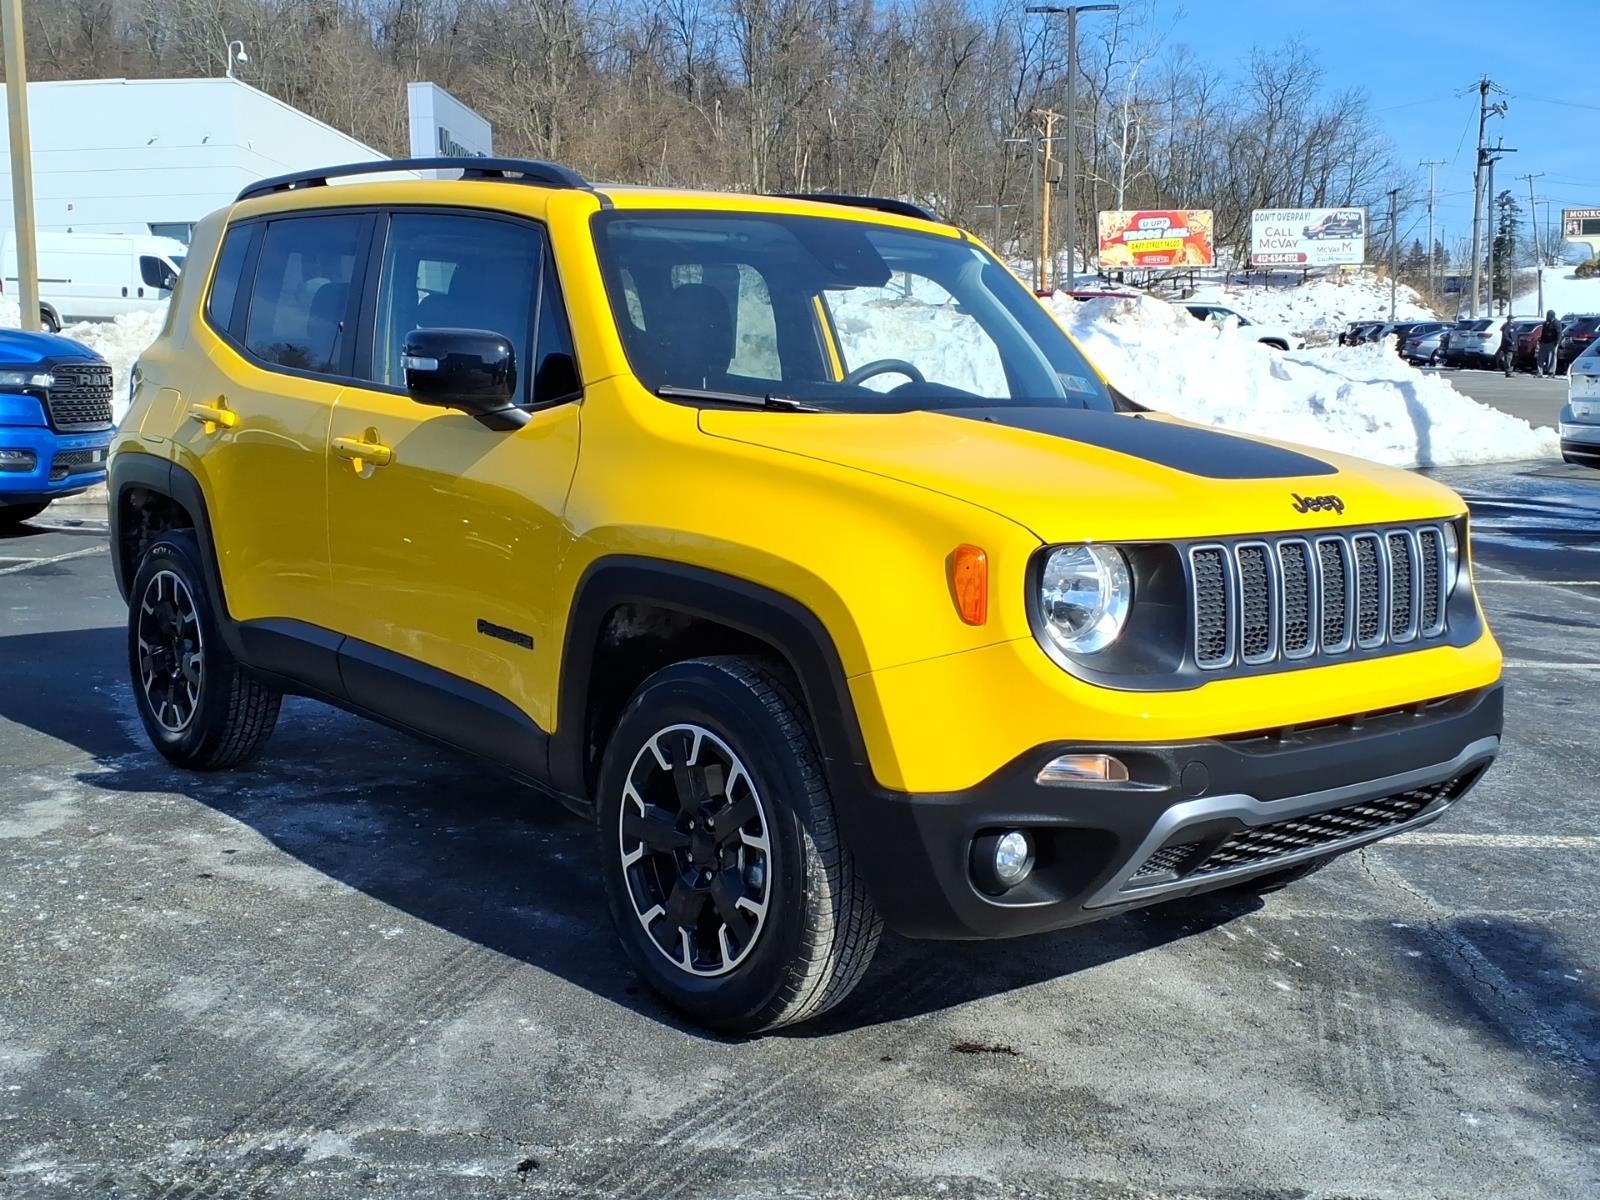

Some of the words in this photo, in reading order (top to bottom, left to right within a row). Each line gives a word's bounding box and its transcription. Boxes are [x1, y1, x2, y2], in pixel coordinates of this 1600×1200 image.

[1255, 212, 1276, 222] DON'T
[1265, 226, 1294, 237] CALL
[79, 374, 110, 386] RAM
[1291, 493, 1345, 515] Jeep
